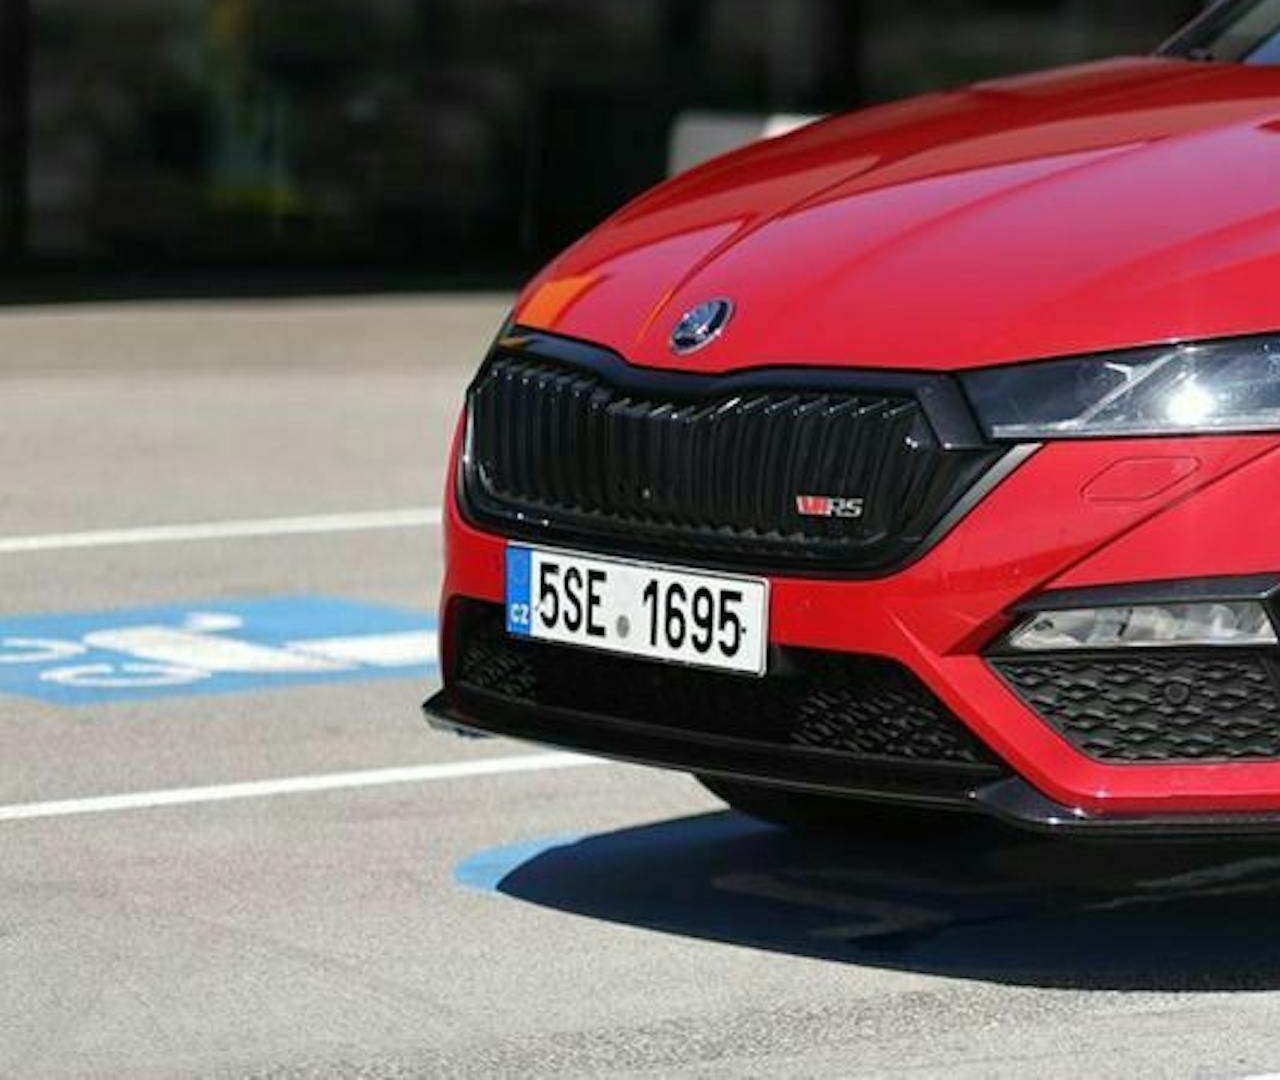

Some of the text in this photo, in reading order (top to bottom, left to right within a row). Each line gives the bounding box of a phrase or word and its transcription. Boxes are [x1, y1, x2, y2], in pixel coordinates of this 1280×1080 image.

[510, 603, 529, 625] CZ
[539, 562, 743, 658] 5SE 1695
